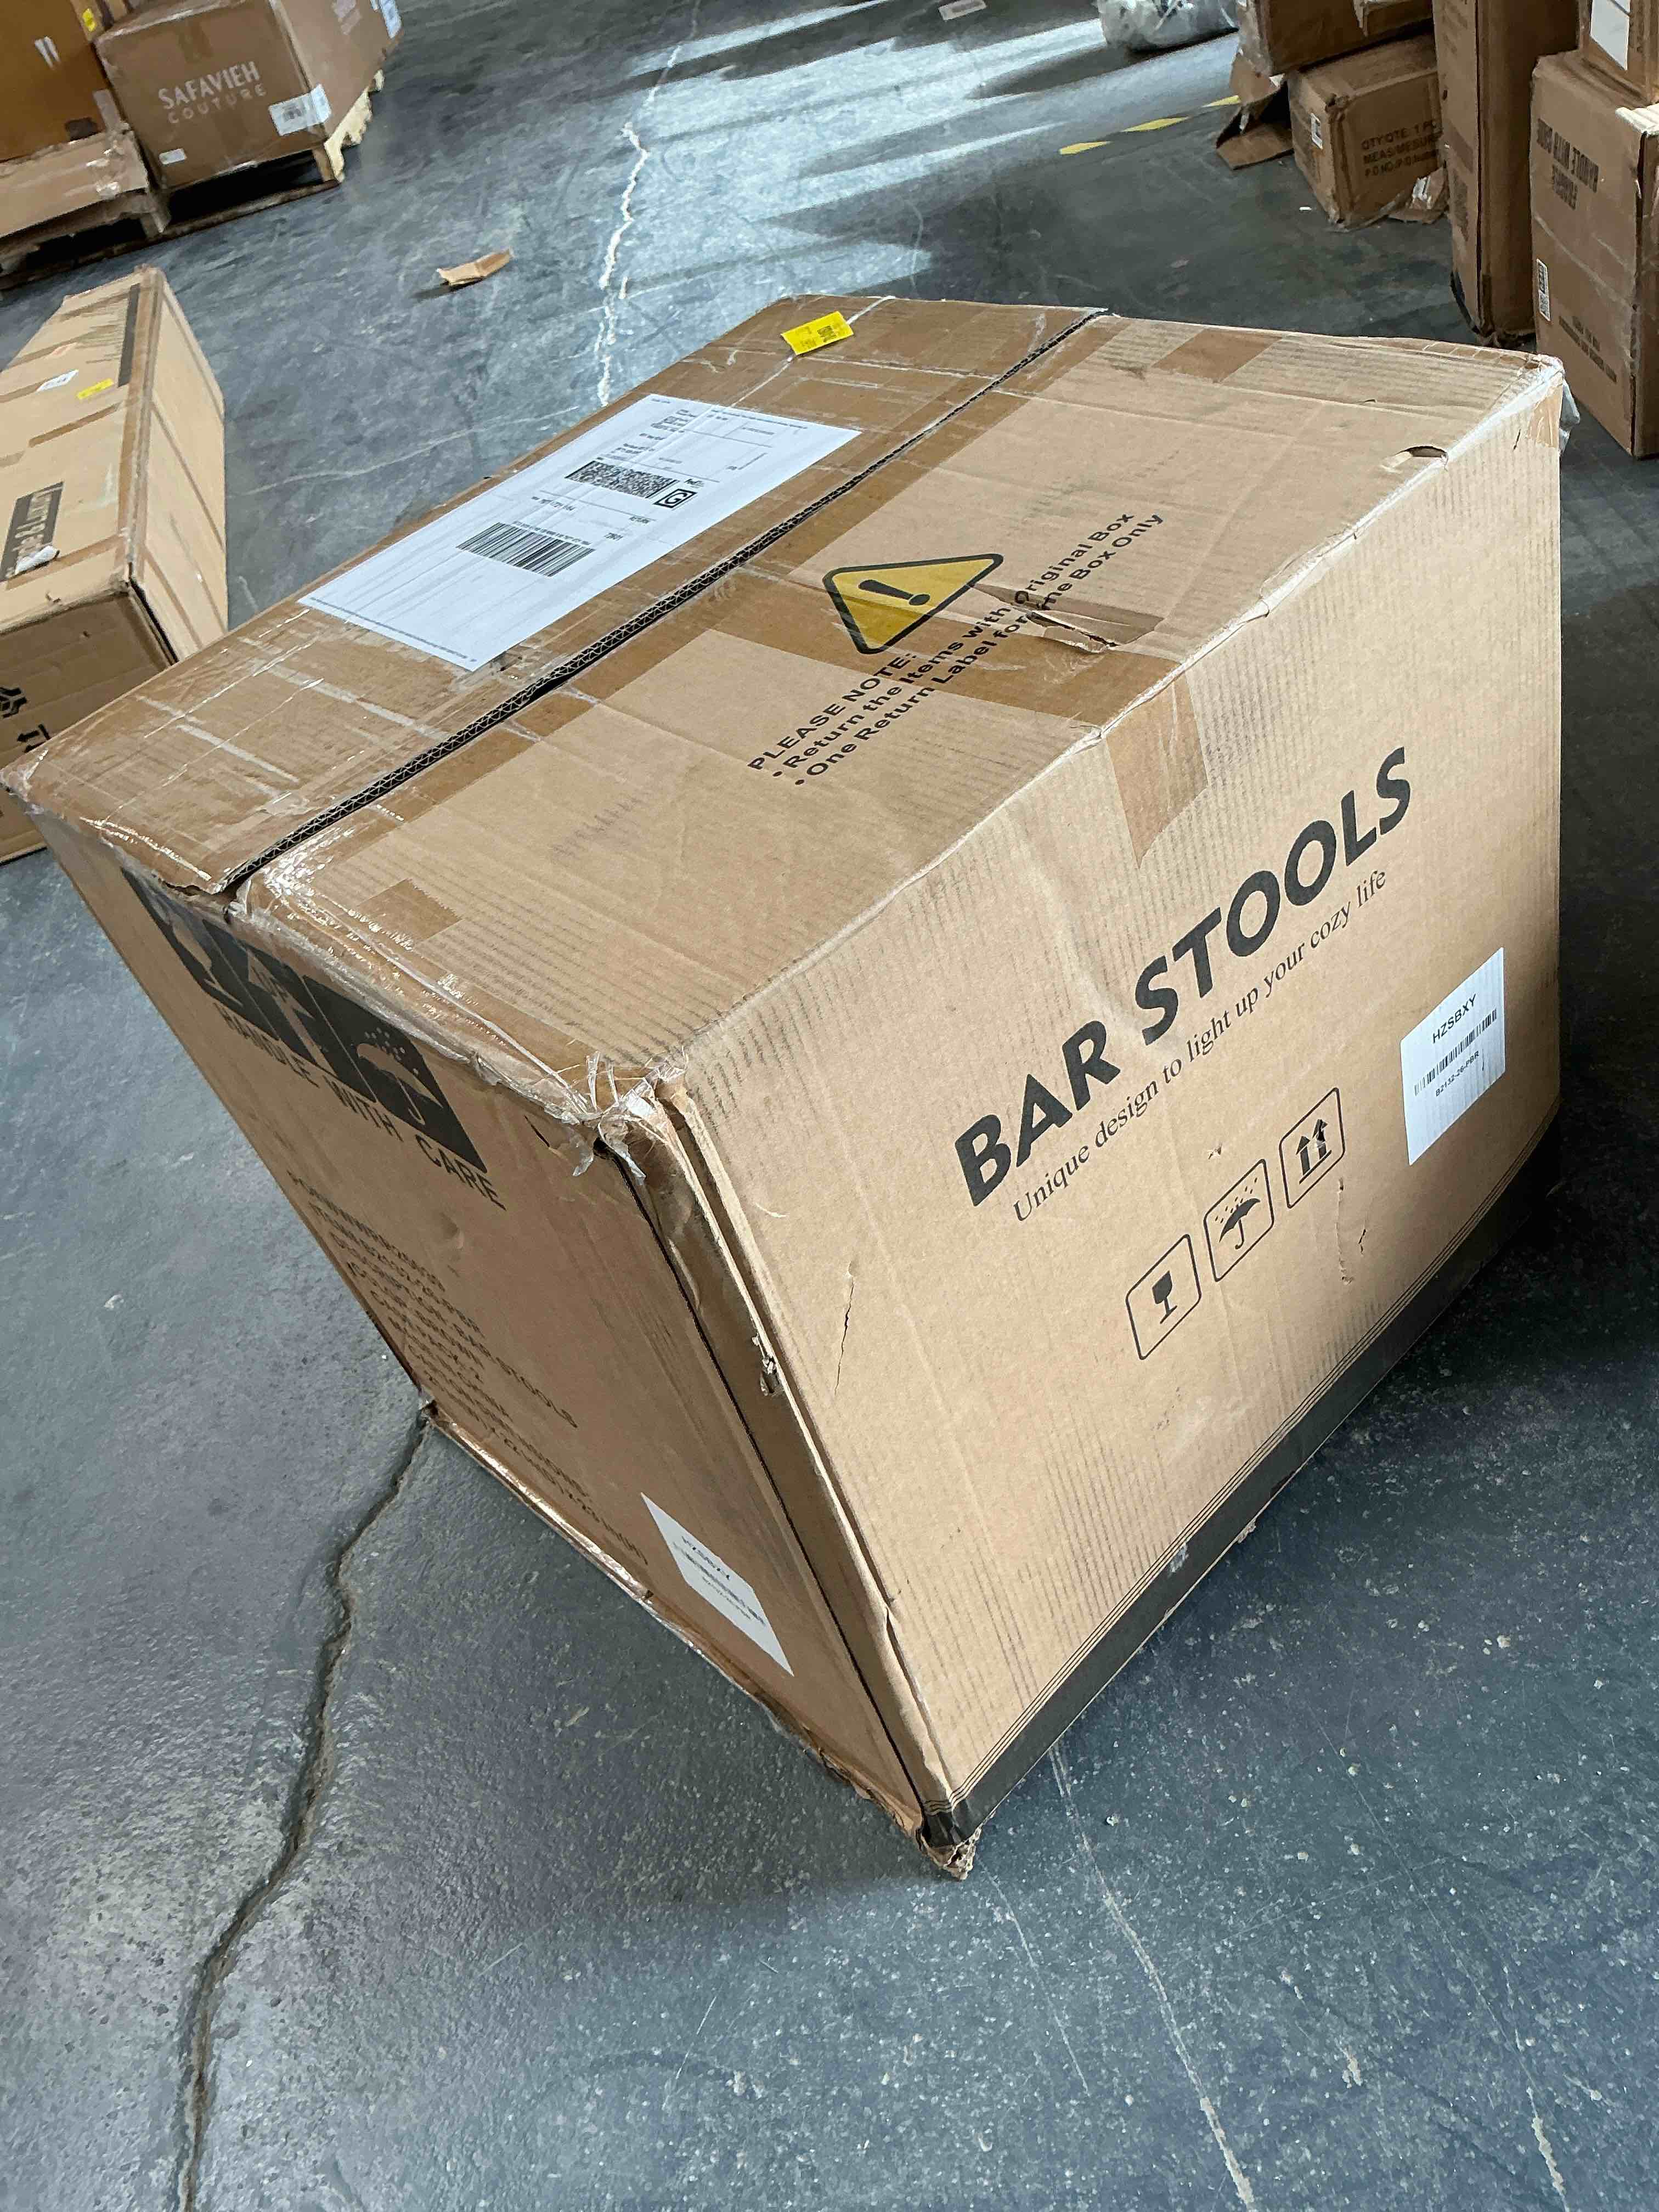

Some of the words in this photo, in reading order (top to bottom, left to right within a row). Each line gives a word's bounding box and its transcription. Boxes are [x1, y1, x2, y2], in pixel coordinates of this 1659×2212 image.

[157, 61, 260, 109] SAFAVIEH
[167, 83, 267, 123] COUTURE
[782, 714, 865, 768] Return
[862, 687, 902, 712] the
[899, 641, 964, 684] Items
[962, 606, 1011, 639] with
[1015, 543, 1093, 604] Original
[1088, 513, 1135, 542] Box
[806, 743, 858, 776] One
[854, 687, 935, 741] Return
[931, 640, 997, 684] Label
[993, 613, 1029, 639] for
[1070, 550, 1116, 580] Box
[1111, 513, 1164, 548] Only
[747, 702, 847, 770] PLEASE
[842, 653, 917, 702] NOTE:
[954, 1020, 1121, 1206] BAR
[1135, 747, 1412, 1046] STOOLS
[1432, 993, 1477, 1044] HZSBXY
[1013, 1144, 1090, 1222] Unique
[1095, 1080, 1159, 1147] design
[1163, 1058, 1182, 1085] to
[1186, 1009, 1232, 1063] light
[1234, 987, 1259, 1017] up
[1263, 942, 1305, 998] your
[1310, 901, 1351, 949] cozy
[1356, 870, 1386, 908] life
[322, 1075, 404, 1142] WITH
[415, 1134, 507, 1211] CARE
[495, 1356, 578, 1427] STOOLS
